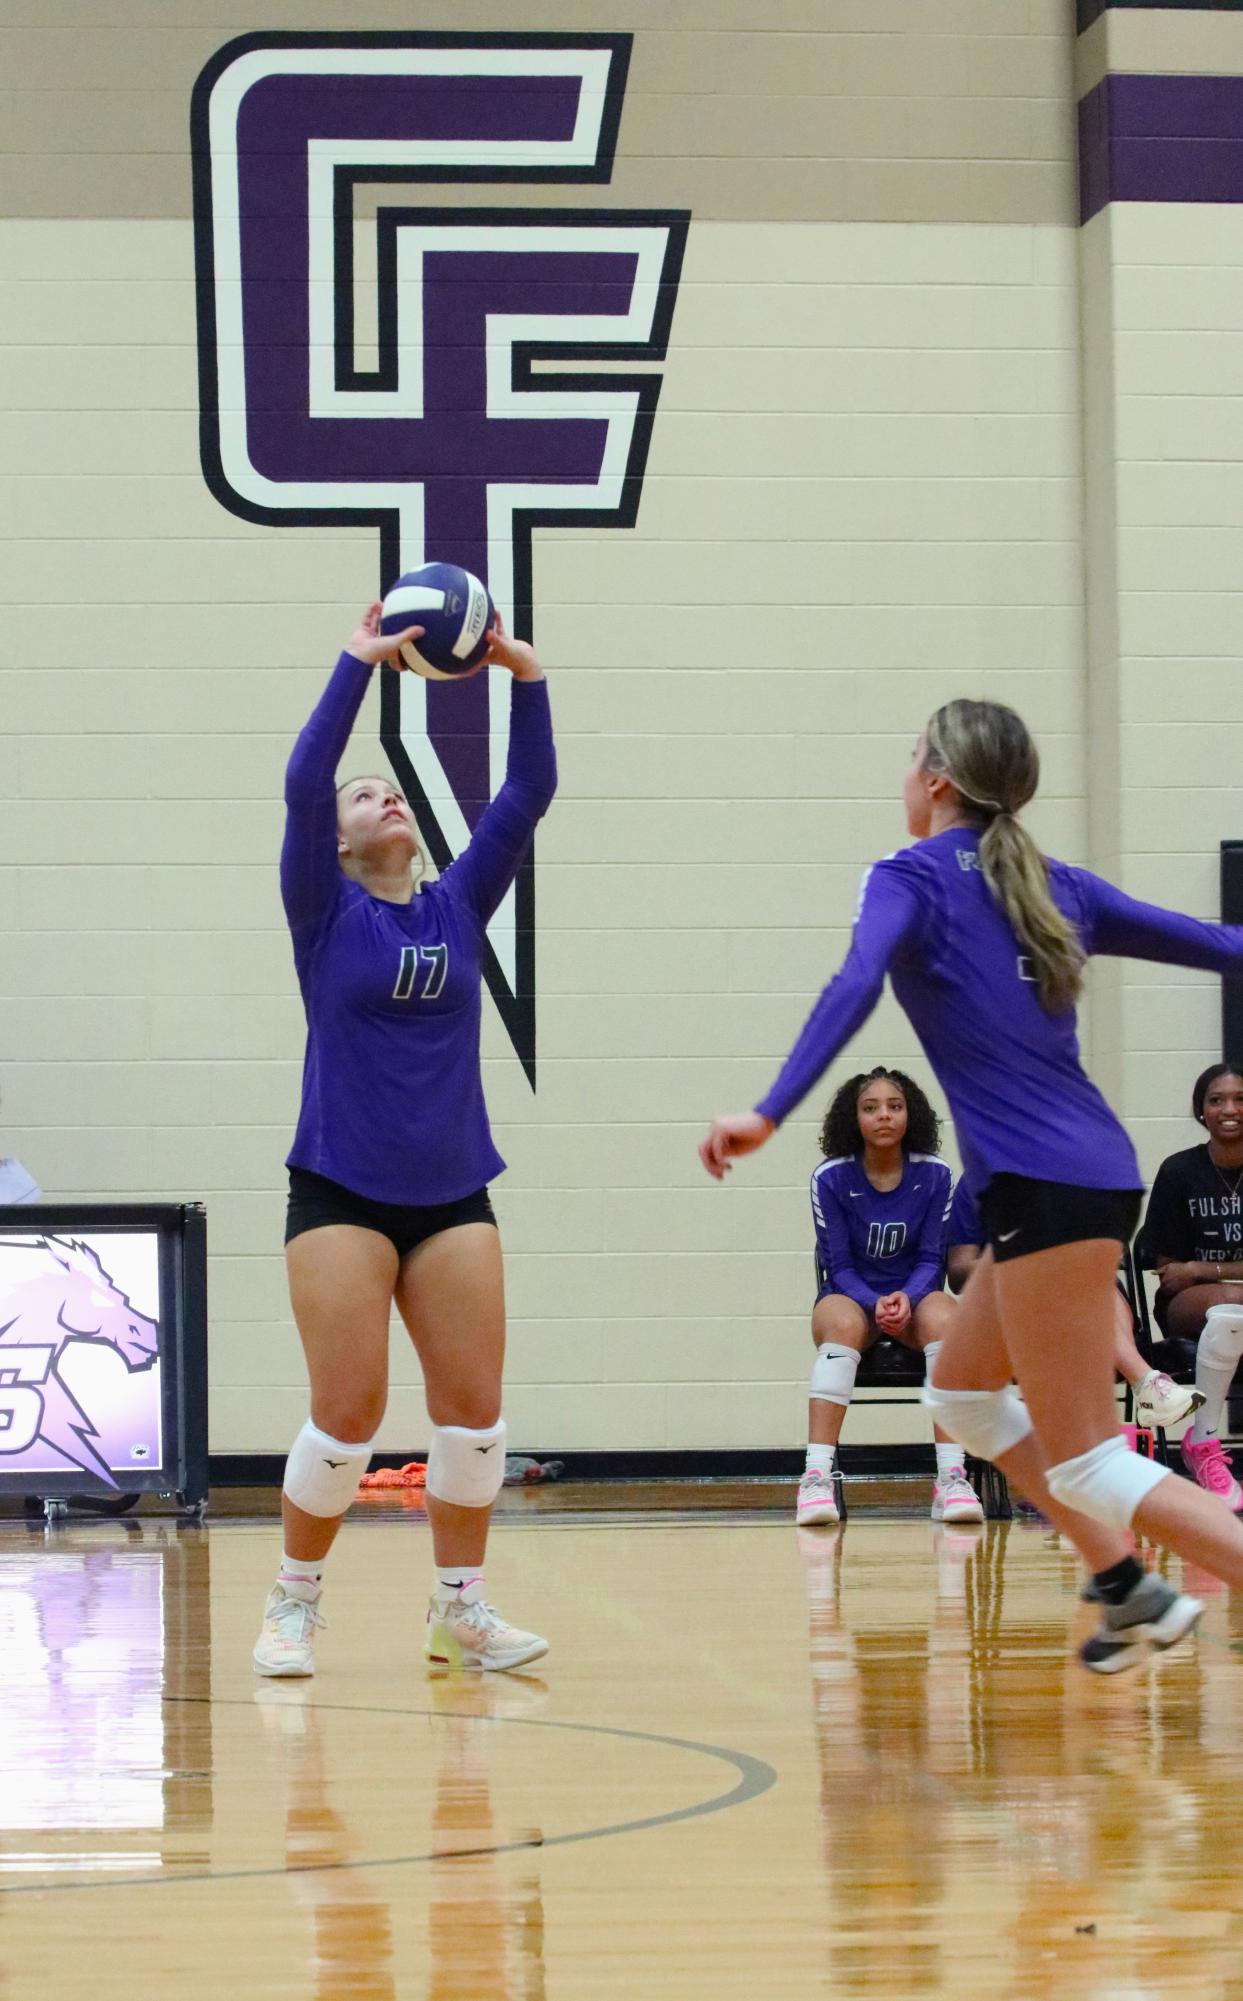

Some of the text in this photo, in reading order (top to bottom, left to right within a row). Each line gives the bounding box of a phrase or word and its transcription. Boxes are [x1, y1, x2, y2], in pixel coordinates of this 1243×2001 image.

[392, 943, 448, 999] 17
[1188, 1196, 1241, 1218] FULSH
[866, 1222, 907, 1259] 10
[1223, 1222, 1242, 1242] VS
